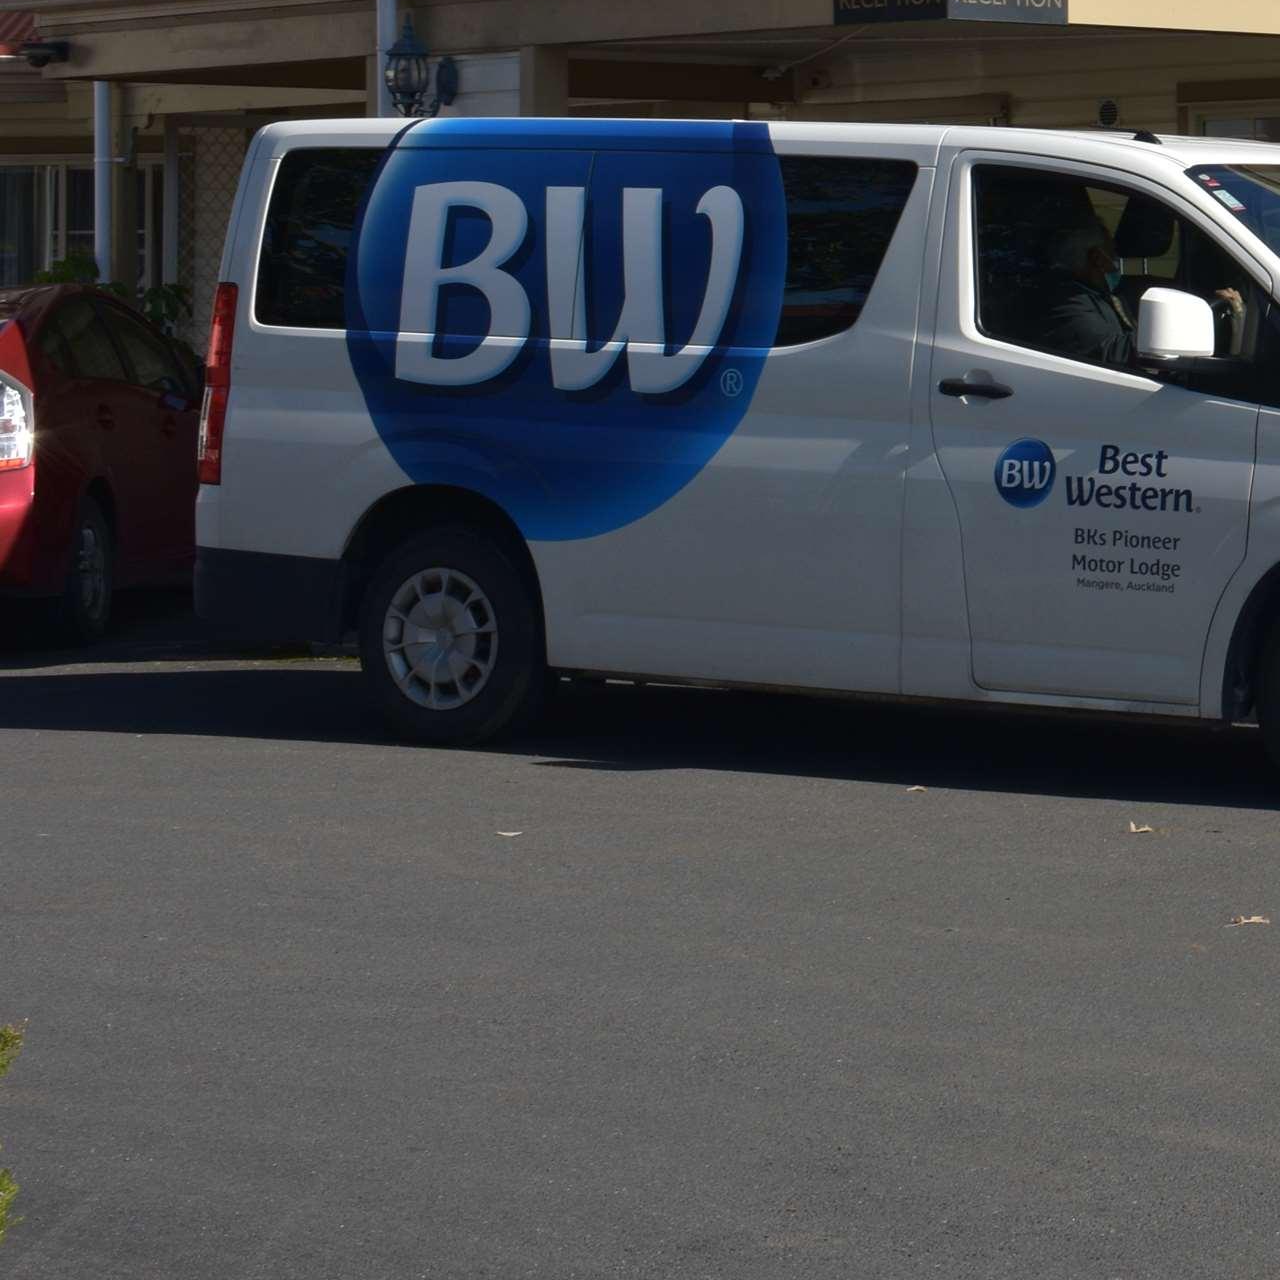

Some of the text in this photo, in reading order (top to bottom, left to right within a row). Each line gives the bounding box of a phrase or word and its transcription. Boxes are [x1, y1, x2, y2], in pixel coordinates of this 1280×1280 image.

[394, 180, 745, 395] BW
[1001, 459, 1050, 489] BW
[1098, 444, 1169, 478] Best
[1065, 475, 1194, 513] Western
[1073, 527, 1181, 551] BKs Pioneer
[1071, 554, 1181, 581] Motor Lodge
[1076, 578, 1175, 593] Mangere, Auckland
